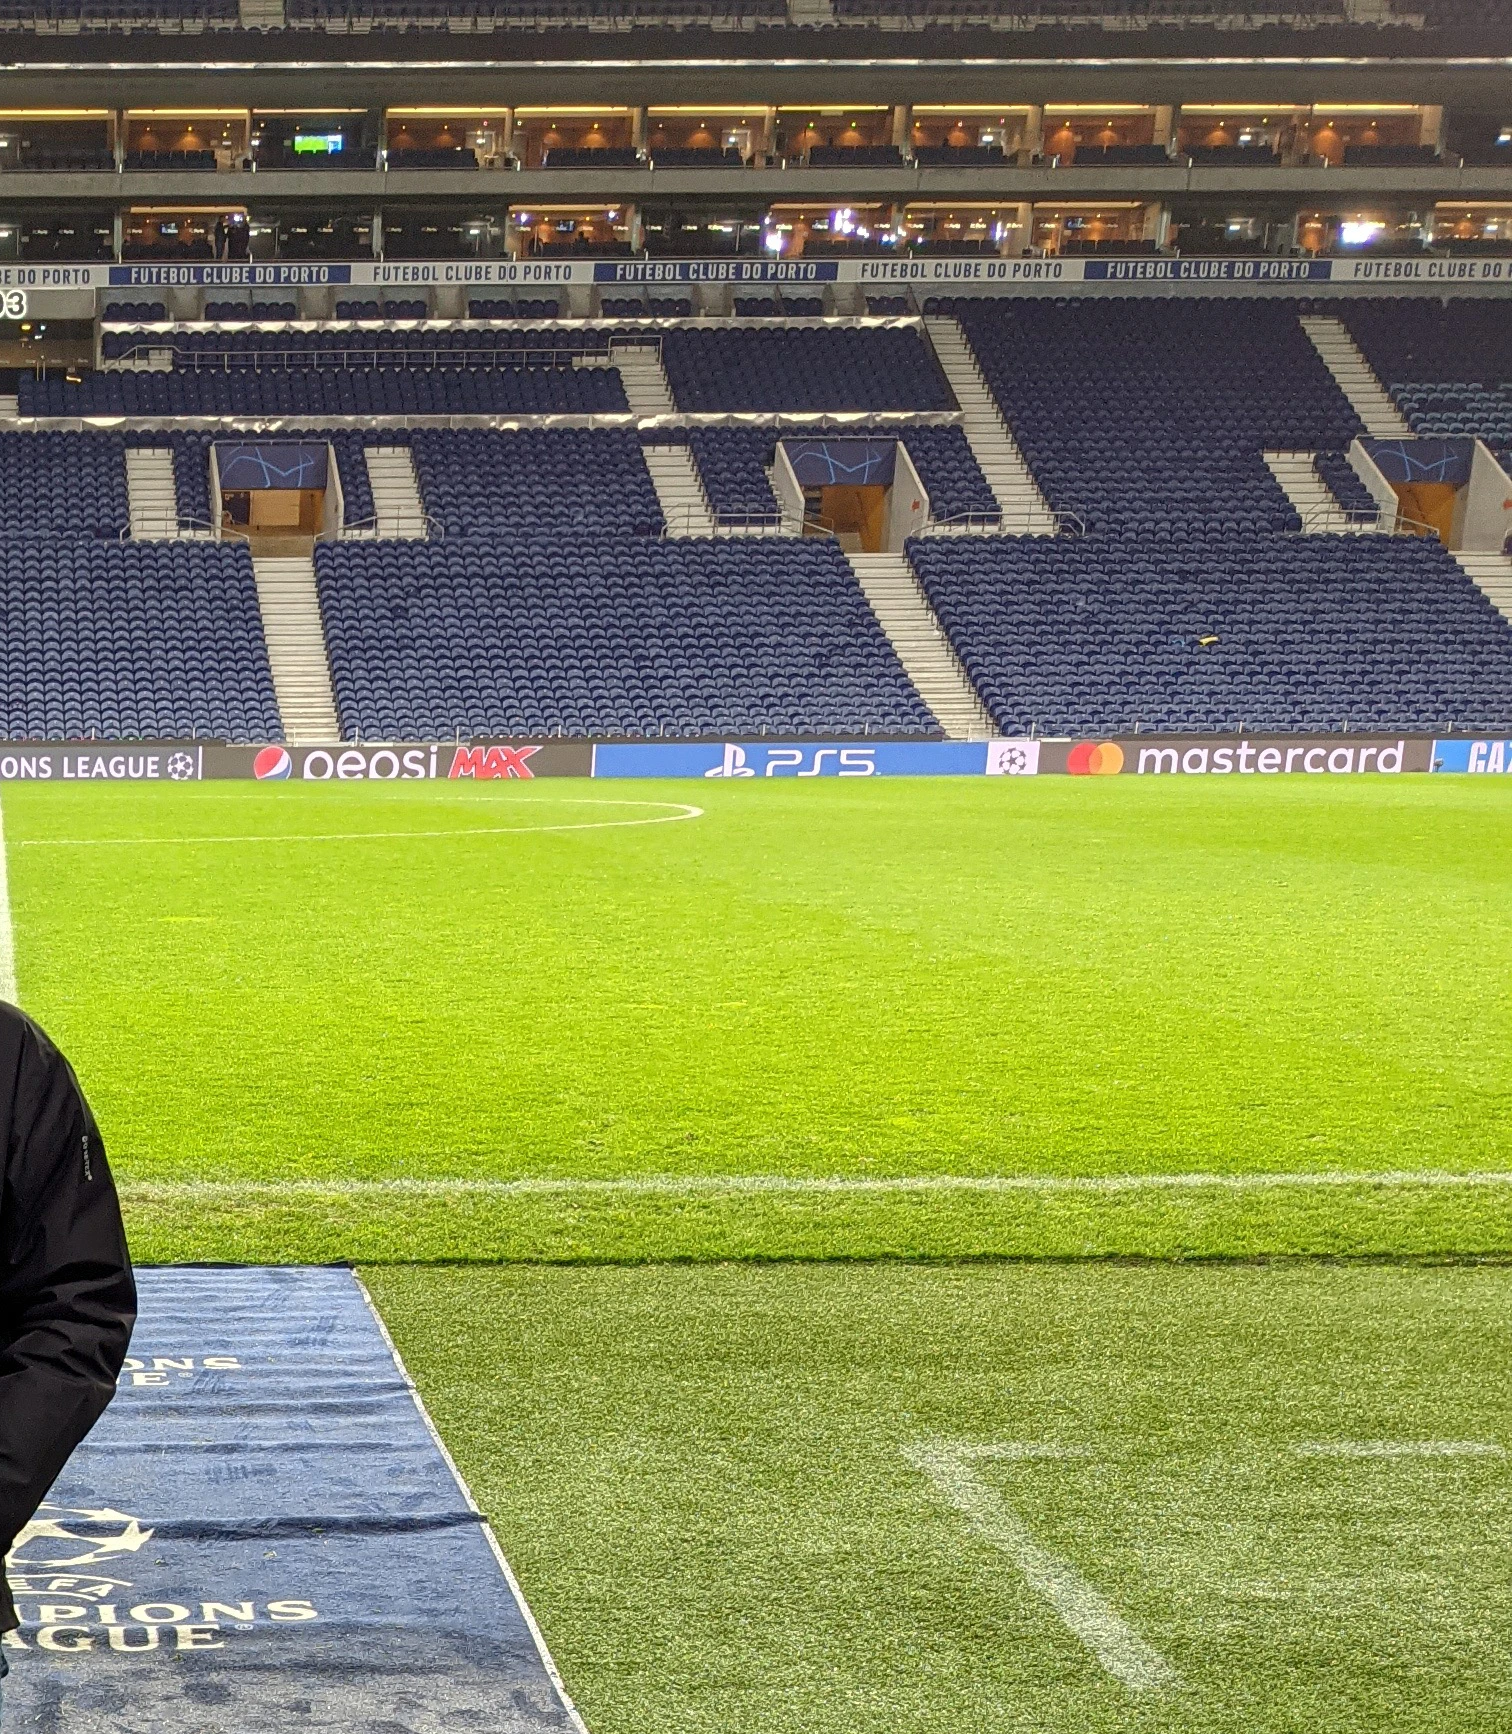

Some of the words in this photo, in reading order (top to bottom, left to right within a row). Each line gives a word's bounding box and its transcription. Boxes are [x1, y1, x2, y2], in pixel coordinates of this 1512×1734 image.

[17, 269, 36, 285] DO
[42, 269, 91, 285] PORTO
[131, 268, 197, 284] FUTEBOL
[202, 268, 249, 284] CLUBE
[255, 268, 275, 284] DO
[280, 268, 329, 284] PORTO
[373, 266, 439, 282] FUTEBOL
[445, 266, 492, 282] CLUBE
[498, 266, 517, 282] DO
[523, 266, 572, 282] PORTO
[616, 264, 683, 280] FUTEBOL
[688, 264, 736, 280] CLUBE
[742, 264, 761, 280] DO
[766, 264, 817, 280] PORTO
[861, 263, 928, 279] FUTEBOL
[934, 263, 981, 279] CLUBE
[987, 263, 1006, 279] DO
[1012, 263, 1062, 279] PORTO
[1106, 262, 1175, 279] FUTEBOL
[1179, 262, 1228, 279] CLUBE
[1233, 262, 1253, 279] DO
[1259, 262, 1310, 279] PORTO
[1353, 262, 1422, 279] FUTEBOL
[1428, 262, 1476, 279] CLUBE
[1481, 262, 1502, 279] DO
[447, 745, 545, 780] MAX
[765, 749, 876, 777] PS5
[1138, 740, 1405, 774] mastercard
[63, 757, 160, 778] LEAGUE
[7, 1578, 115, 1597] EFA
[14, 1601, 318, 1624] PIONS
